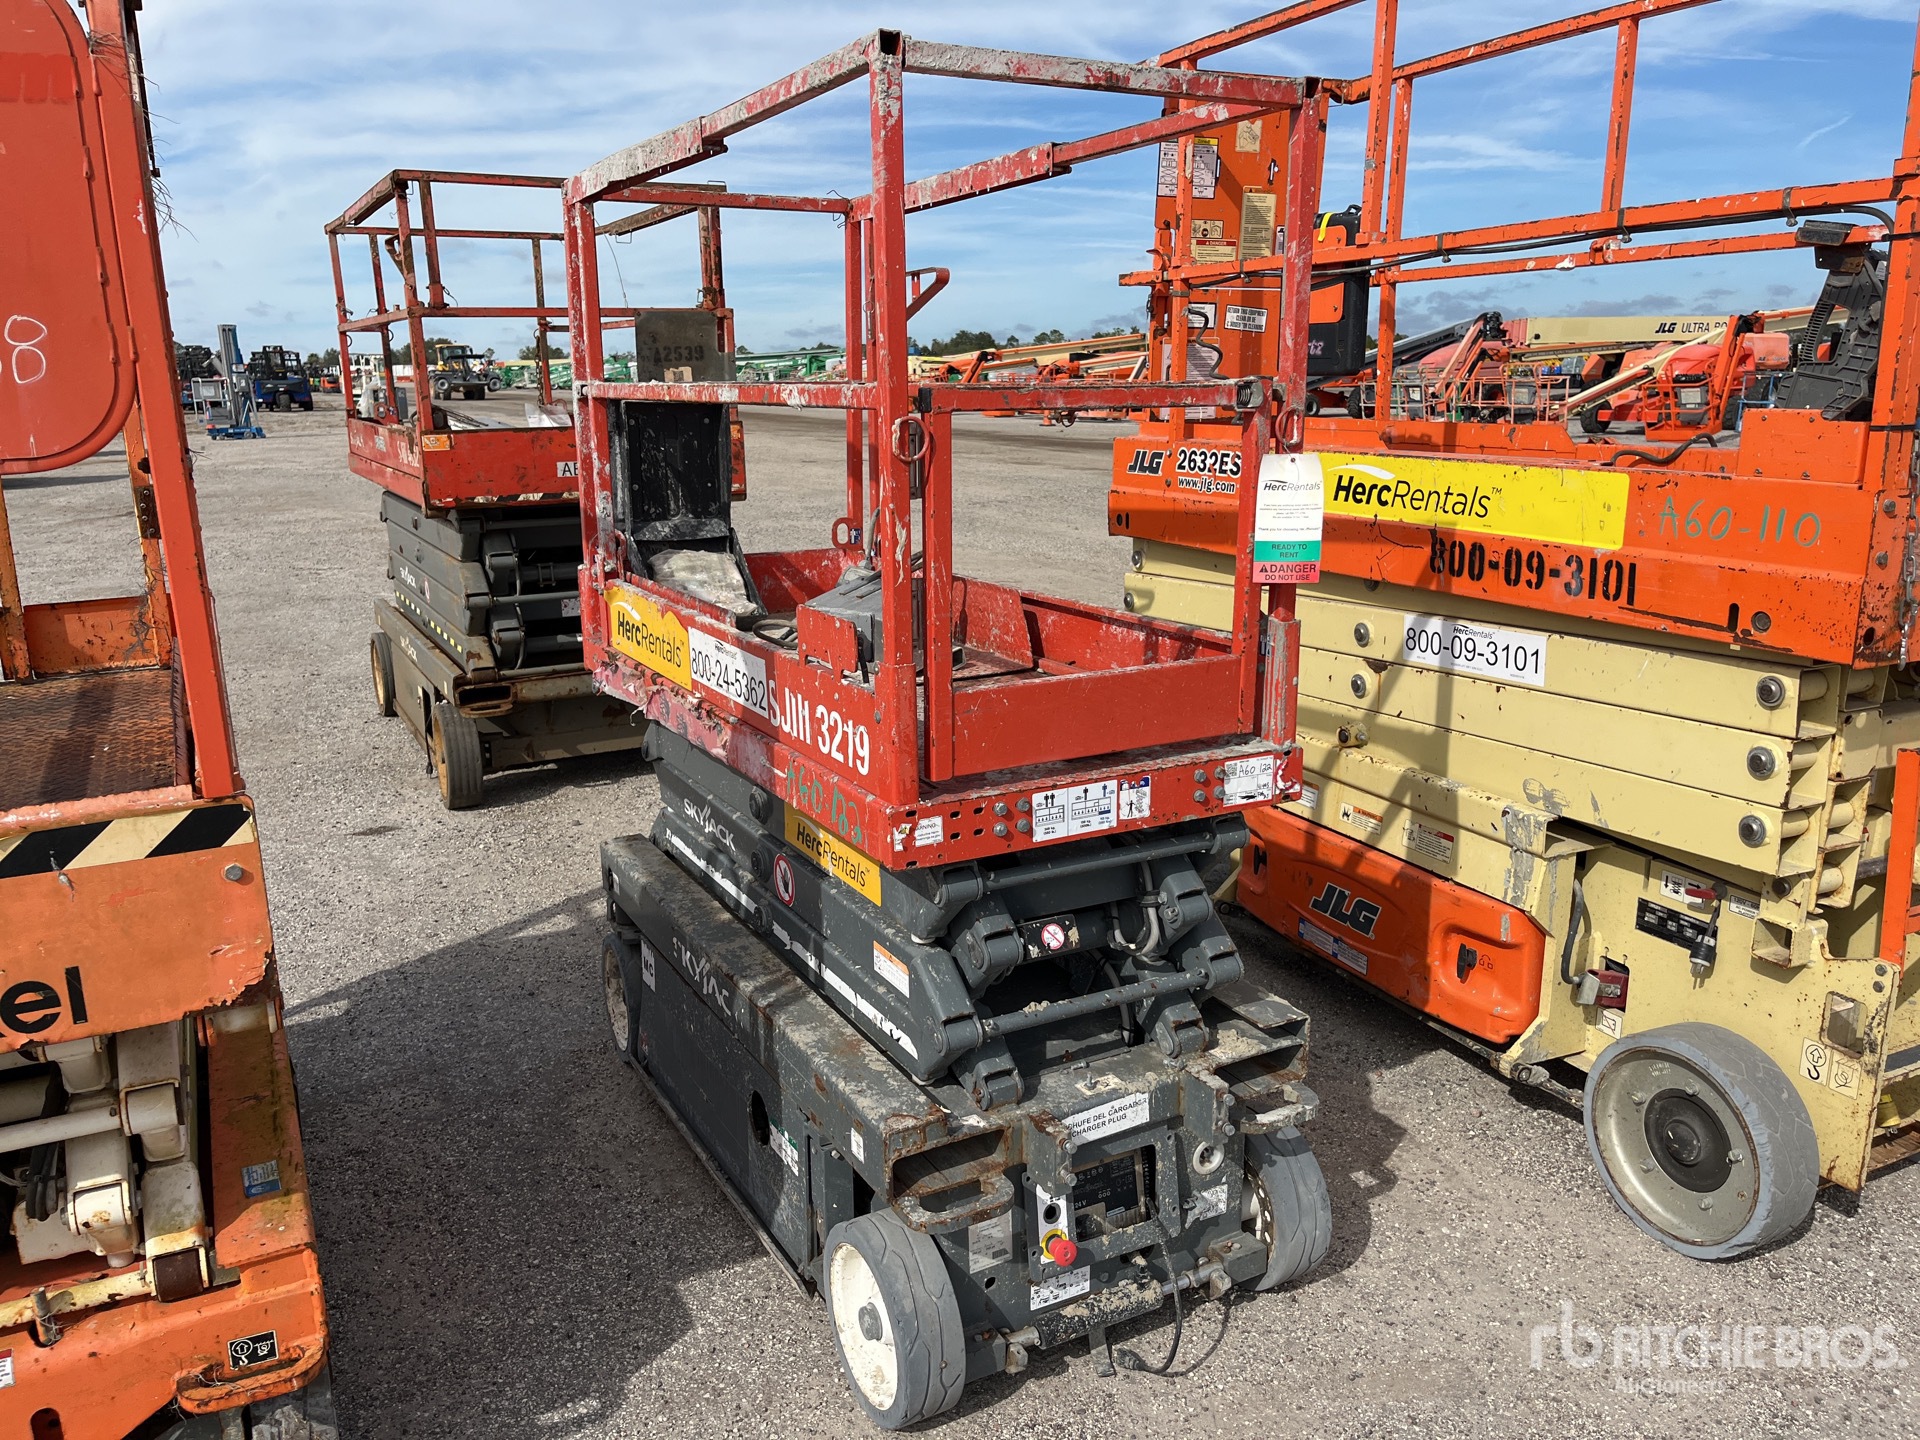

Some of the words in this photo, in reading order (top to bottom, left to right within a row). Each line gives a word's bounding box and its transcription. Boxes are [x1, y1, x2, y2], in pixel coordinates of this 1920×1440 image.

[1655, 322, 1677, 334] JLG
[1682, 322, 1710, 334] ULTRA
[1127, 449, 1164, 476] JLG
[1175, 447, 1242, 478] 2632ES
[1177, 476, 1237, 494] www.jlg.com
[1659, 495, 1822, 548] A60-110
[1270, 563, 1317, 573] DANGER
[1271, 543, 1297, 551] READY
[1429, 537, 1637, 607] 800-09-3101
[1405, 627, 1540, 675] 800-09-3101
[691, 647, 767, 712] 800-24-5362
[815, 704, 870, 776] 3219
[683, 798, 736, 852] SKYJACK
[1309, 882, 1382, 939] JLG
[0, 966, 88, 1037] el
[1071, 1120, 1107, 1138] CHARGER
[1107, 1114, 1127, 1125] PLUG
[1092, 1112, 1107, 1122] DEL
